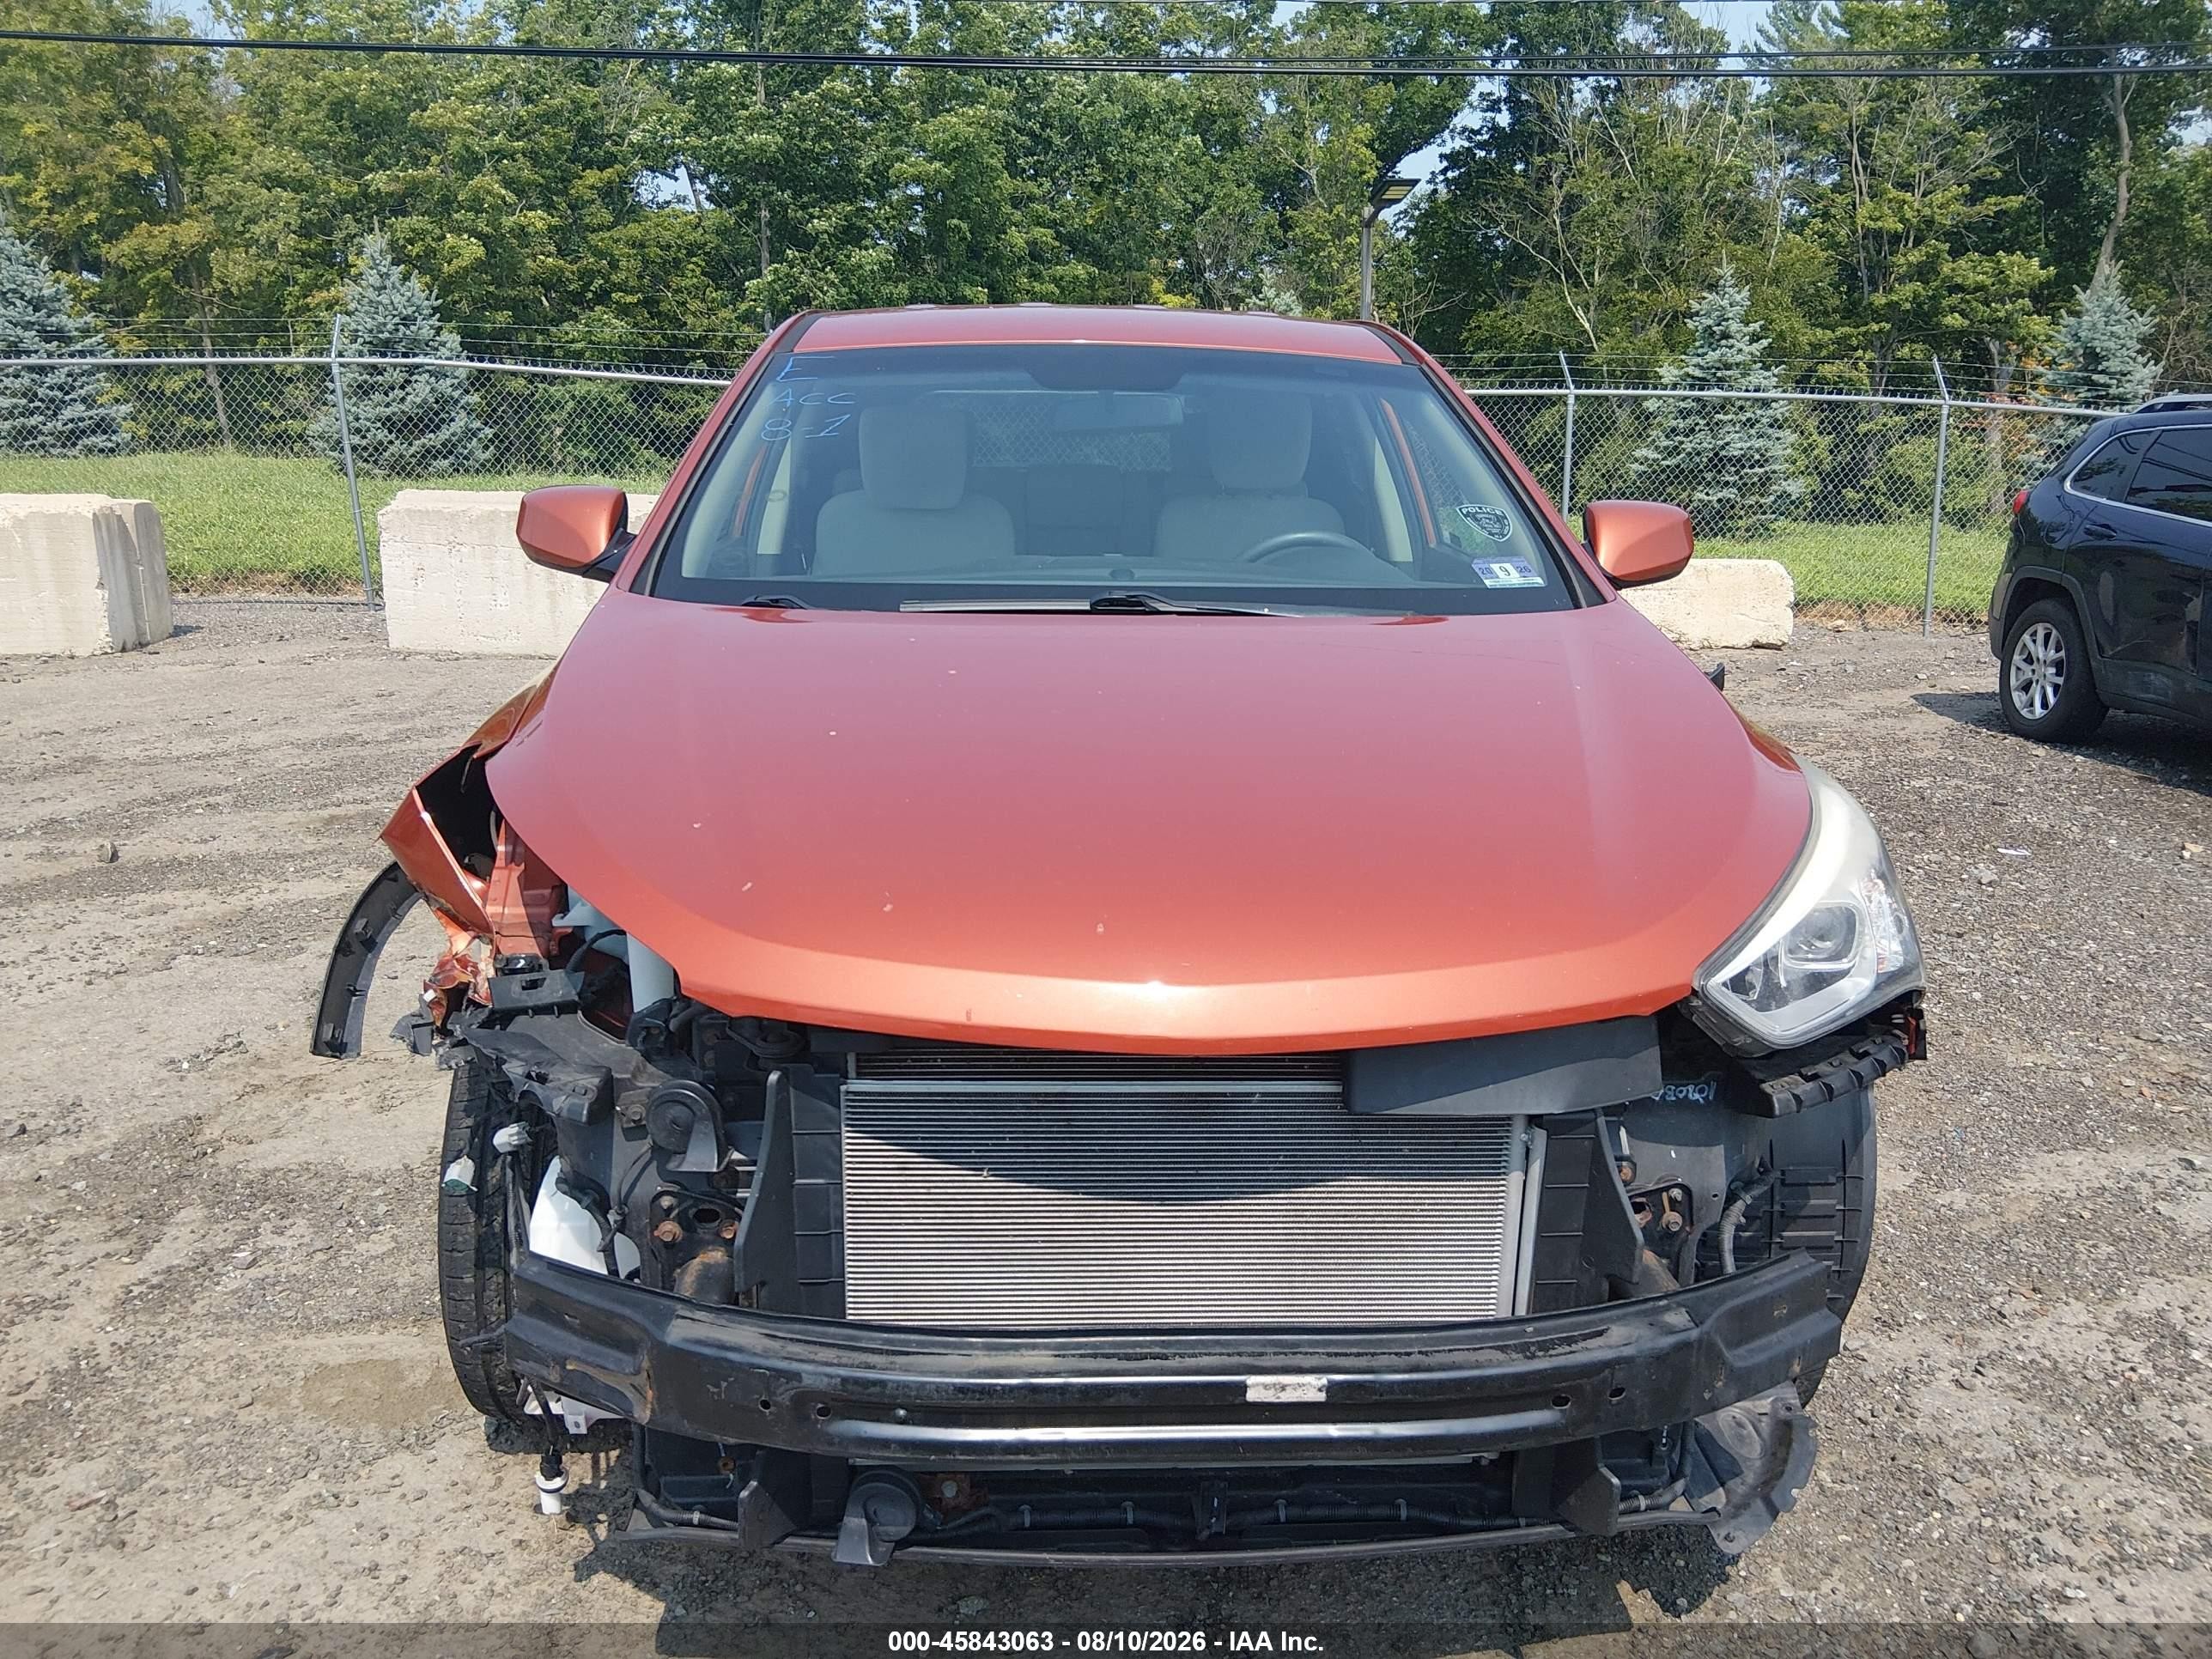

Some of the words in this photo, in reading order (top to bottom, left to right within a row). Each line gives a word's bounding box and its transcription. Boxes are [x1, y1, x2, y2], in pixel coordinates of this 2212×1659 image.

[776, 356, 836, 382] E
[769, 388, 857, 408] ACC
[1462, 506, 1504, 516] POLICE
[1478, 567, 1494, 575] 20
[1498, 565, 1511, 577] 9
[1516, 565, 1532, 574] 26
